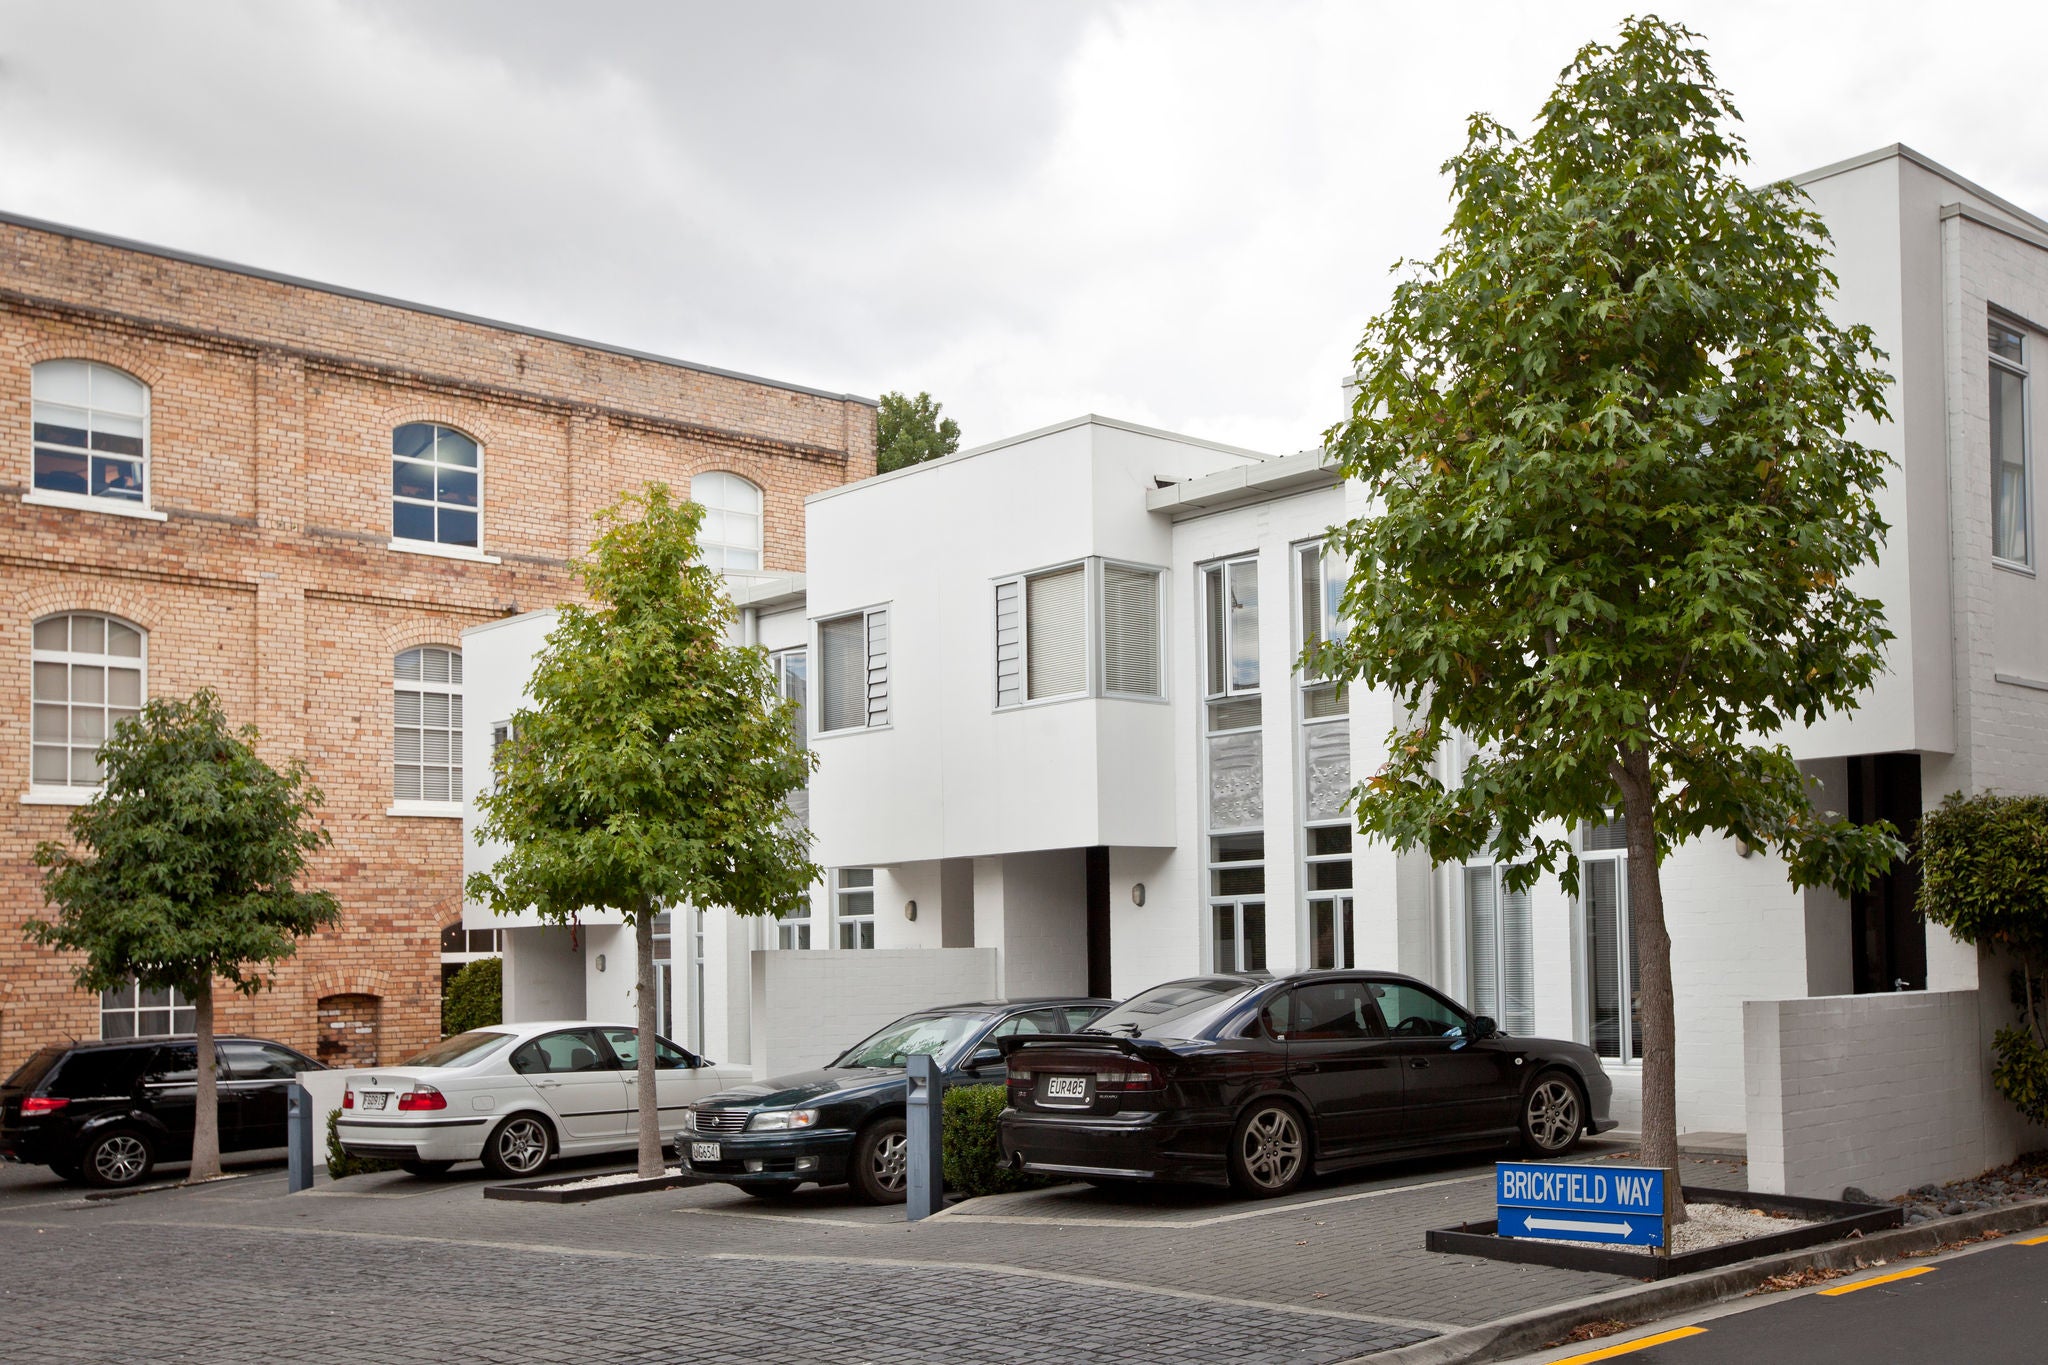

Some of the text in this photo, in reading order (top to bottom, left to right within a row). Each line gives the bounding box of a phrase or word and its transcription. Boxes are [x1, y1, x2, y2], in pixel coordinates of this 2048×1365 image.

[1049, 1079, 1085, 1096] EUR405
[1503, 1170, 1654, 1207] BRICKFIELD WAY
